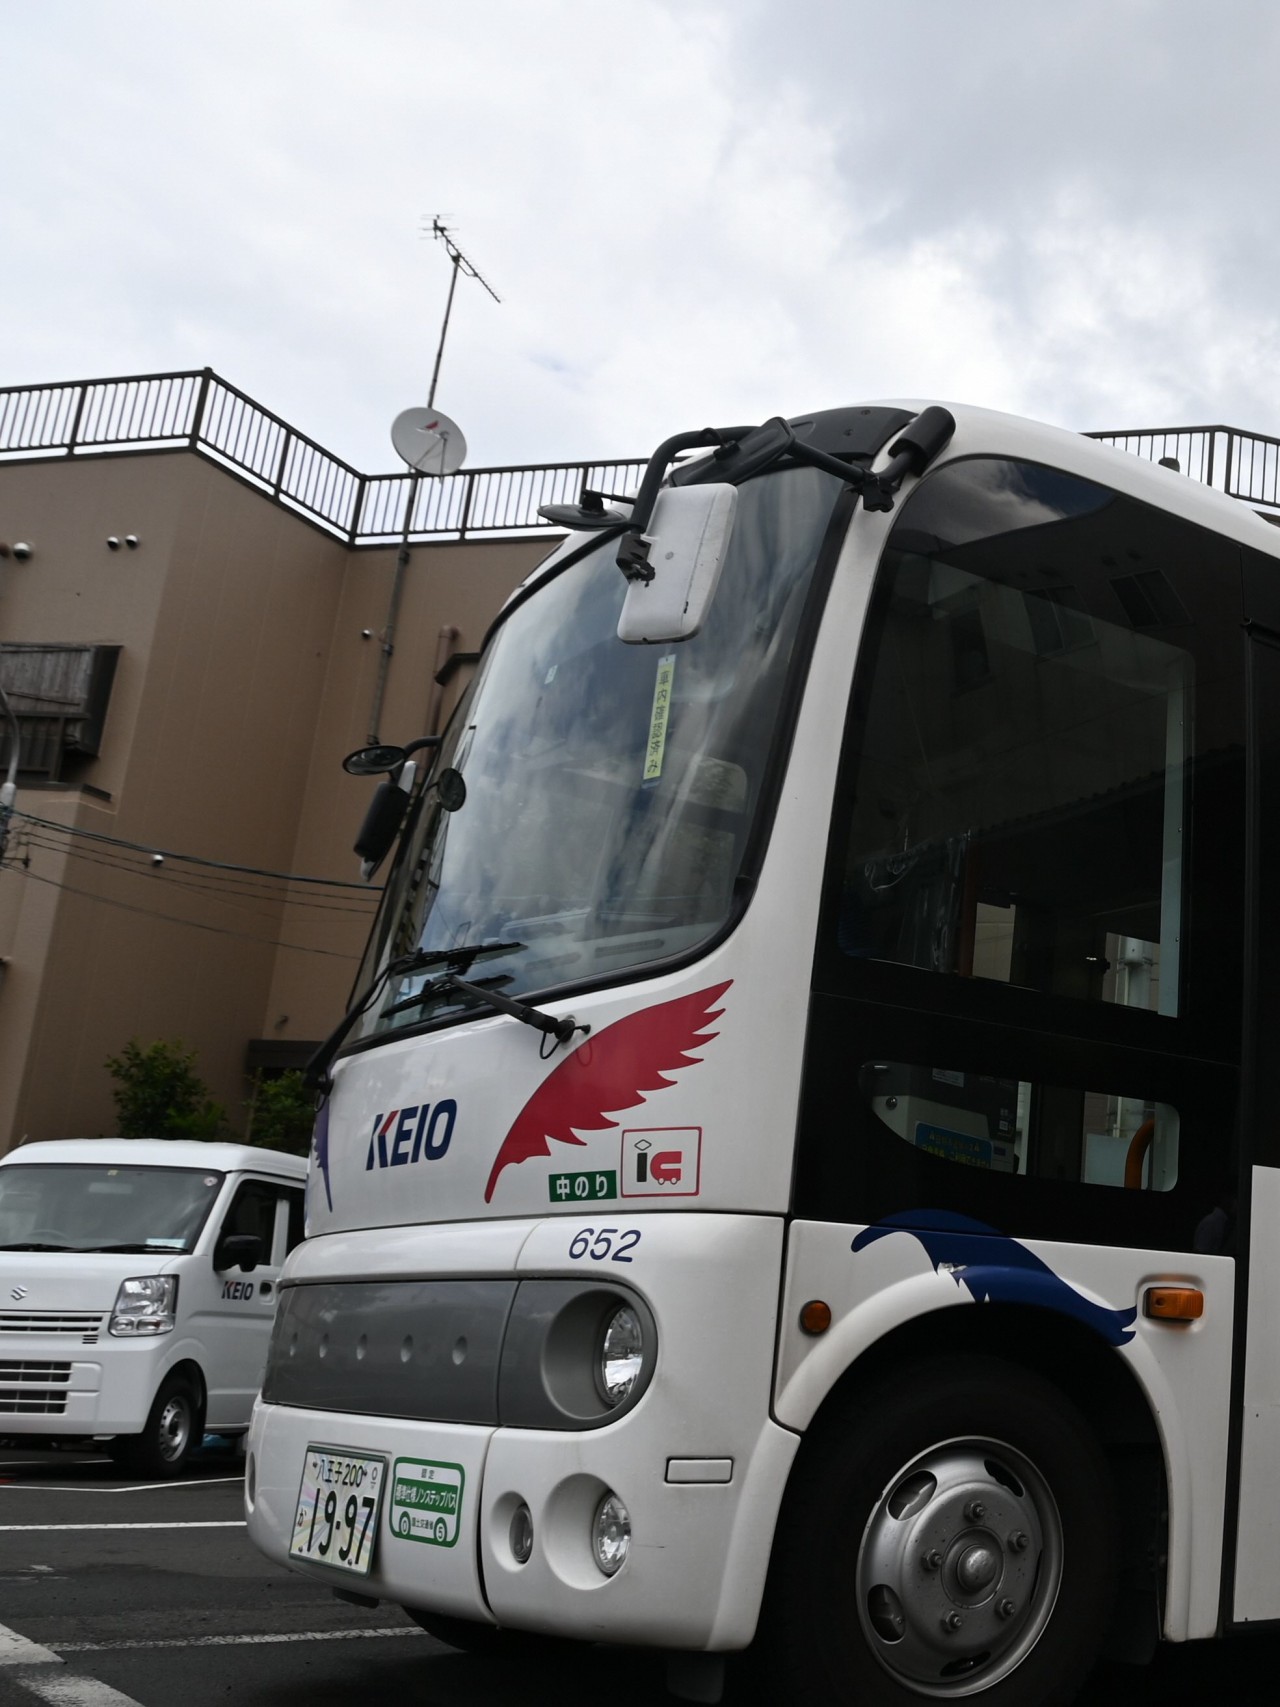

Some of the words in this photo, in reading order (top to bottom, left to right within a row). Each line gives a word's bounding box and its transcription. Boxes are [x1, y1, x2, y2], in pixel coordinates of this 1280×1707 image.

[366, 1098, 457, 1171] KEIO
[556, 1174, 608, 1200] 中のり
[568, 1228, 642, 1263] 652
[221, 1280, 254, 1301] KEIO
